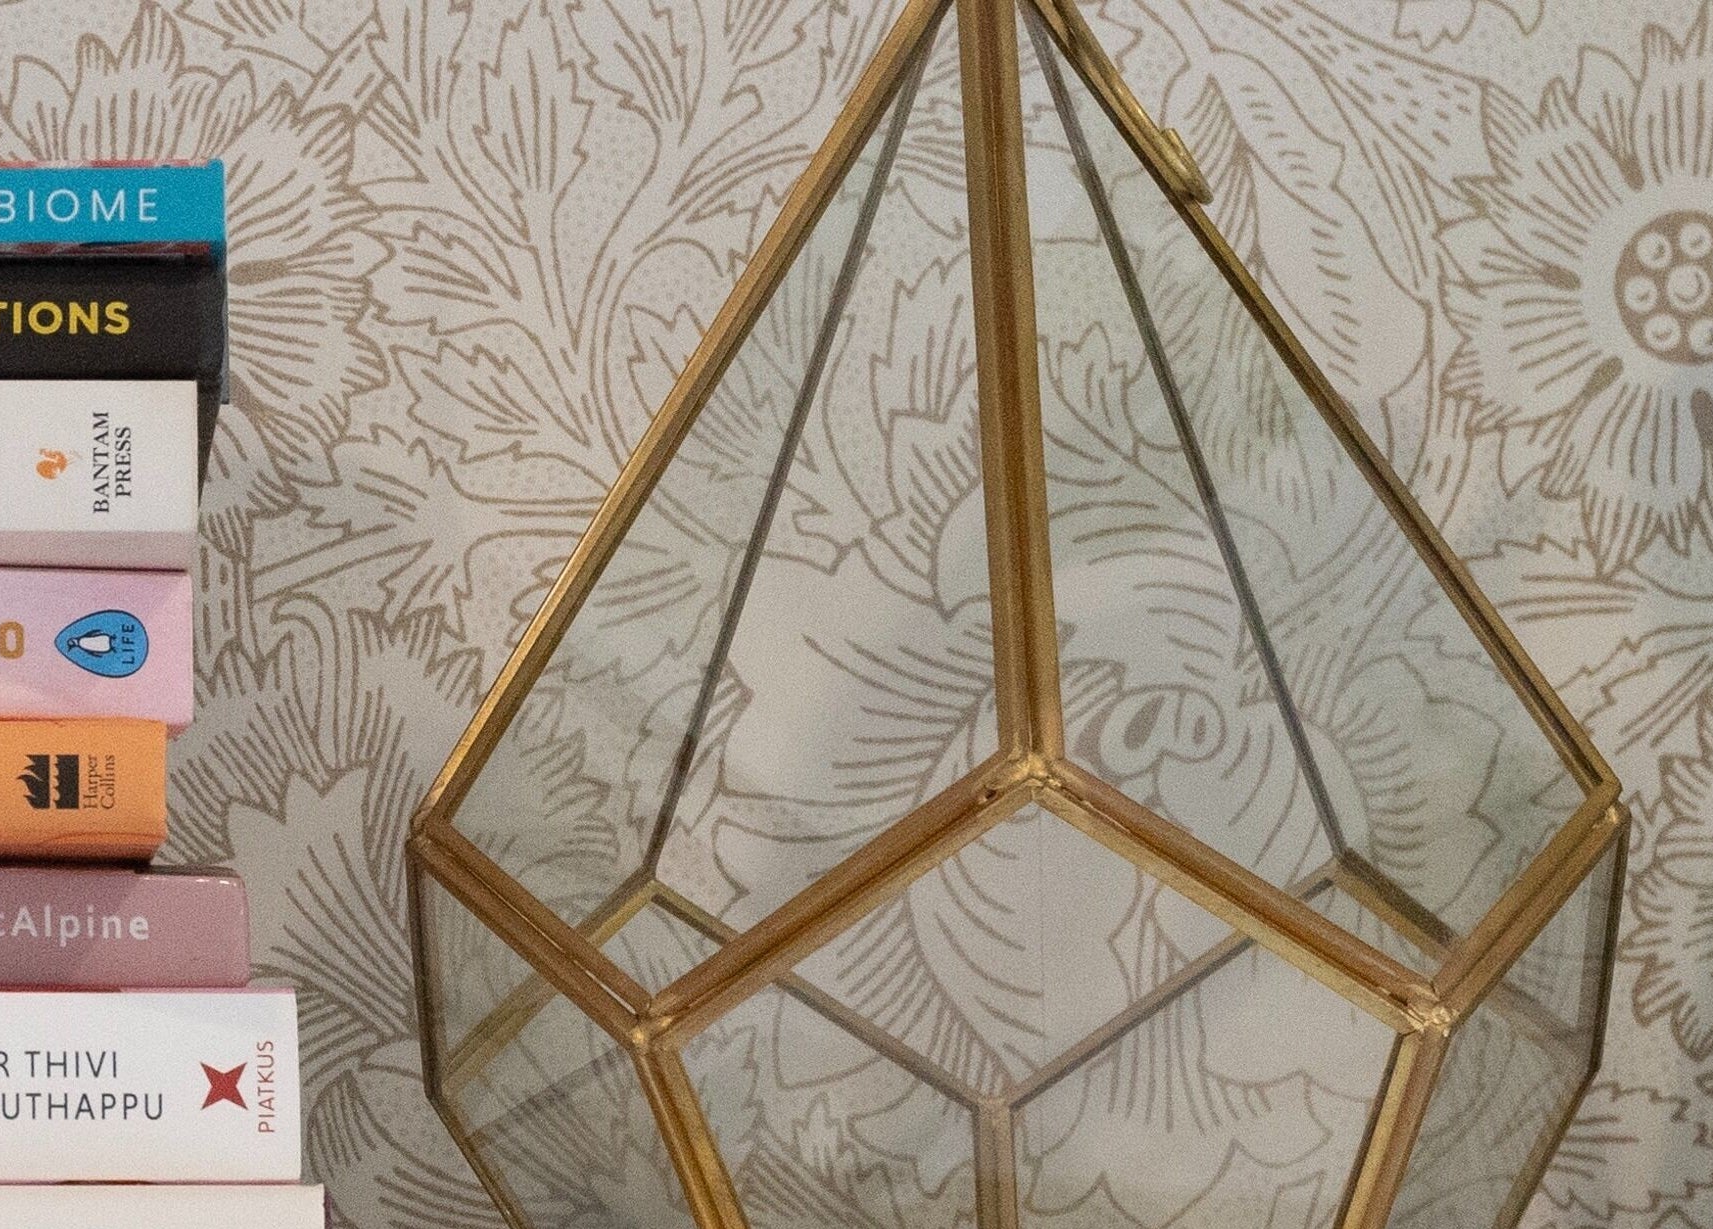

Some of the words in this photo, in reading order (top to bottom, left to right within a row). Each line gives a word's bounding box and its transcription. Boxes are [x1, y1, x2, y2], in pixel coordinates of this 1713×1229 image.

[93, 410, 110, 514] BANTAM
[117, 426, 132, 497] PRESS
[121, 623, 136, 667] LIFE
[83, 753, 99, 809] Harper
[100, 754, 117, 809] Collins
[25, 1050, 119, 1079] THIVI
[258, 1039, 276, 1134] PIATKUS
